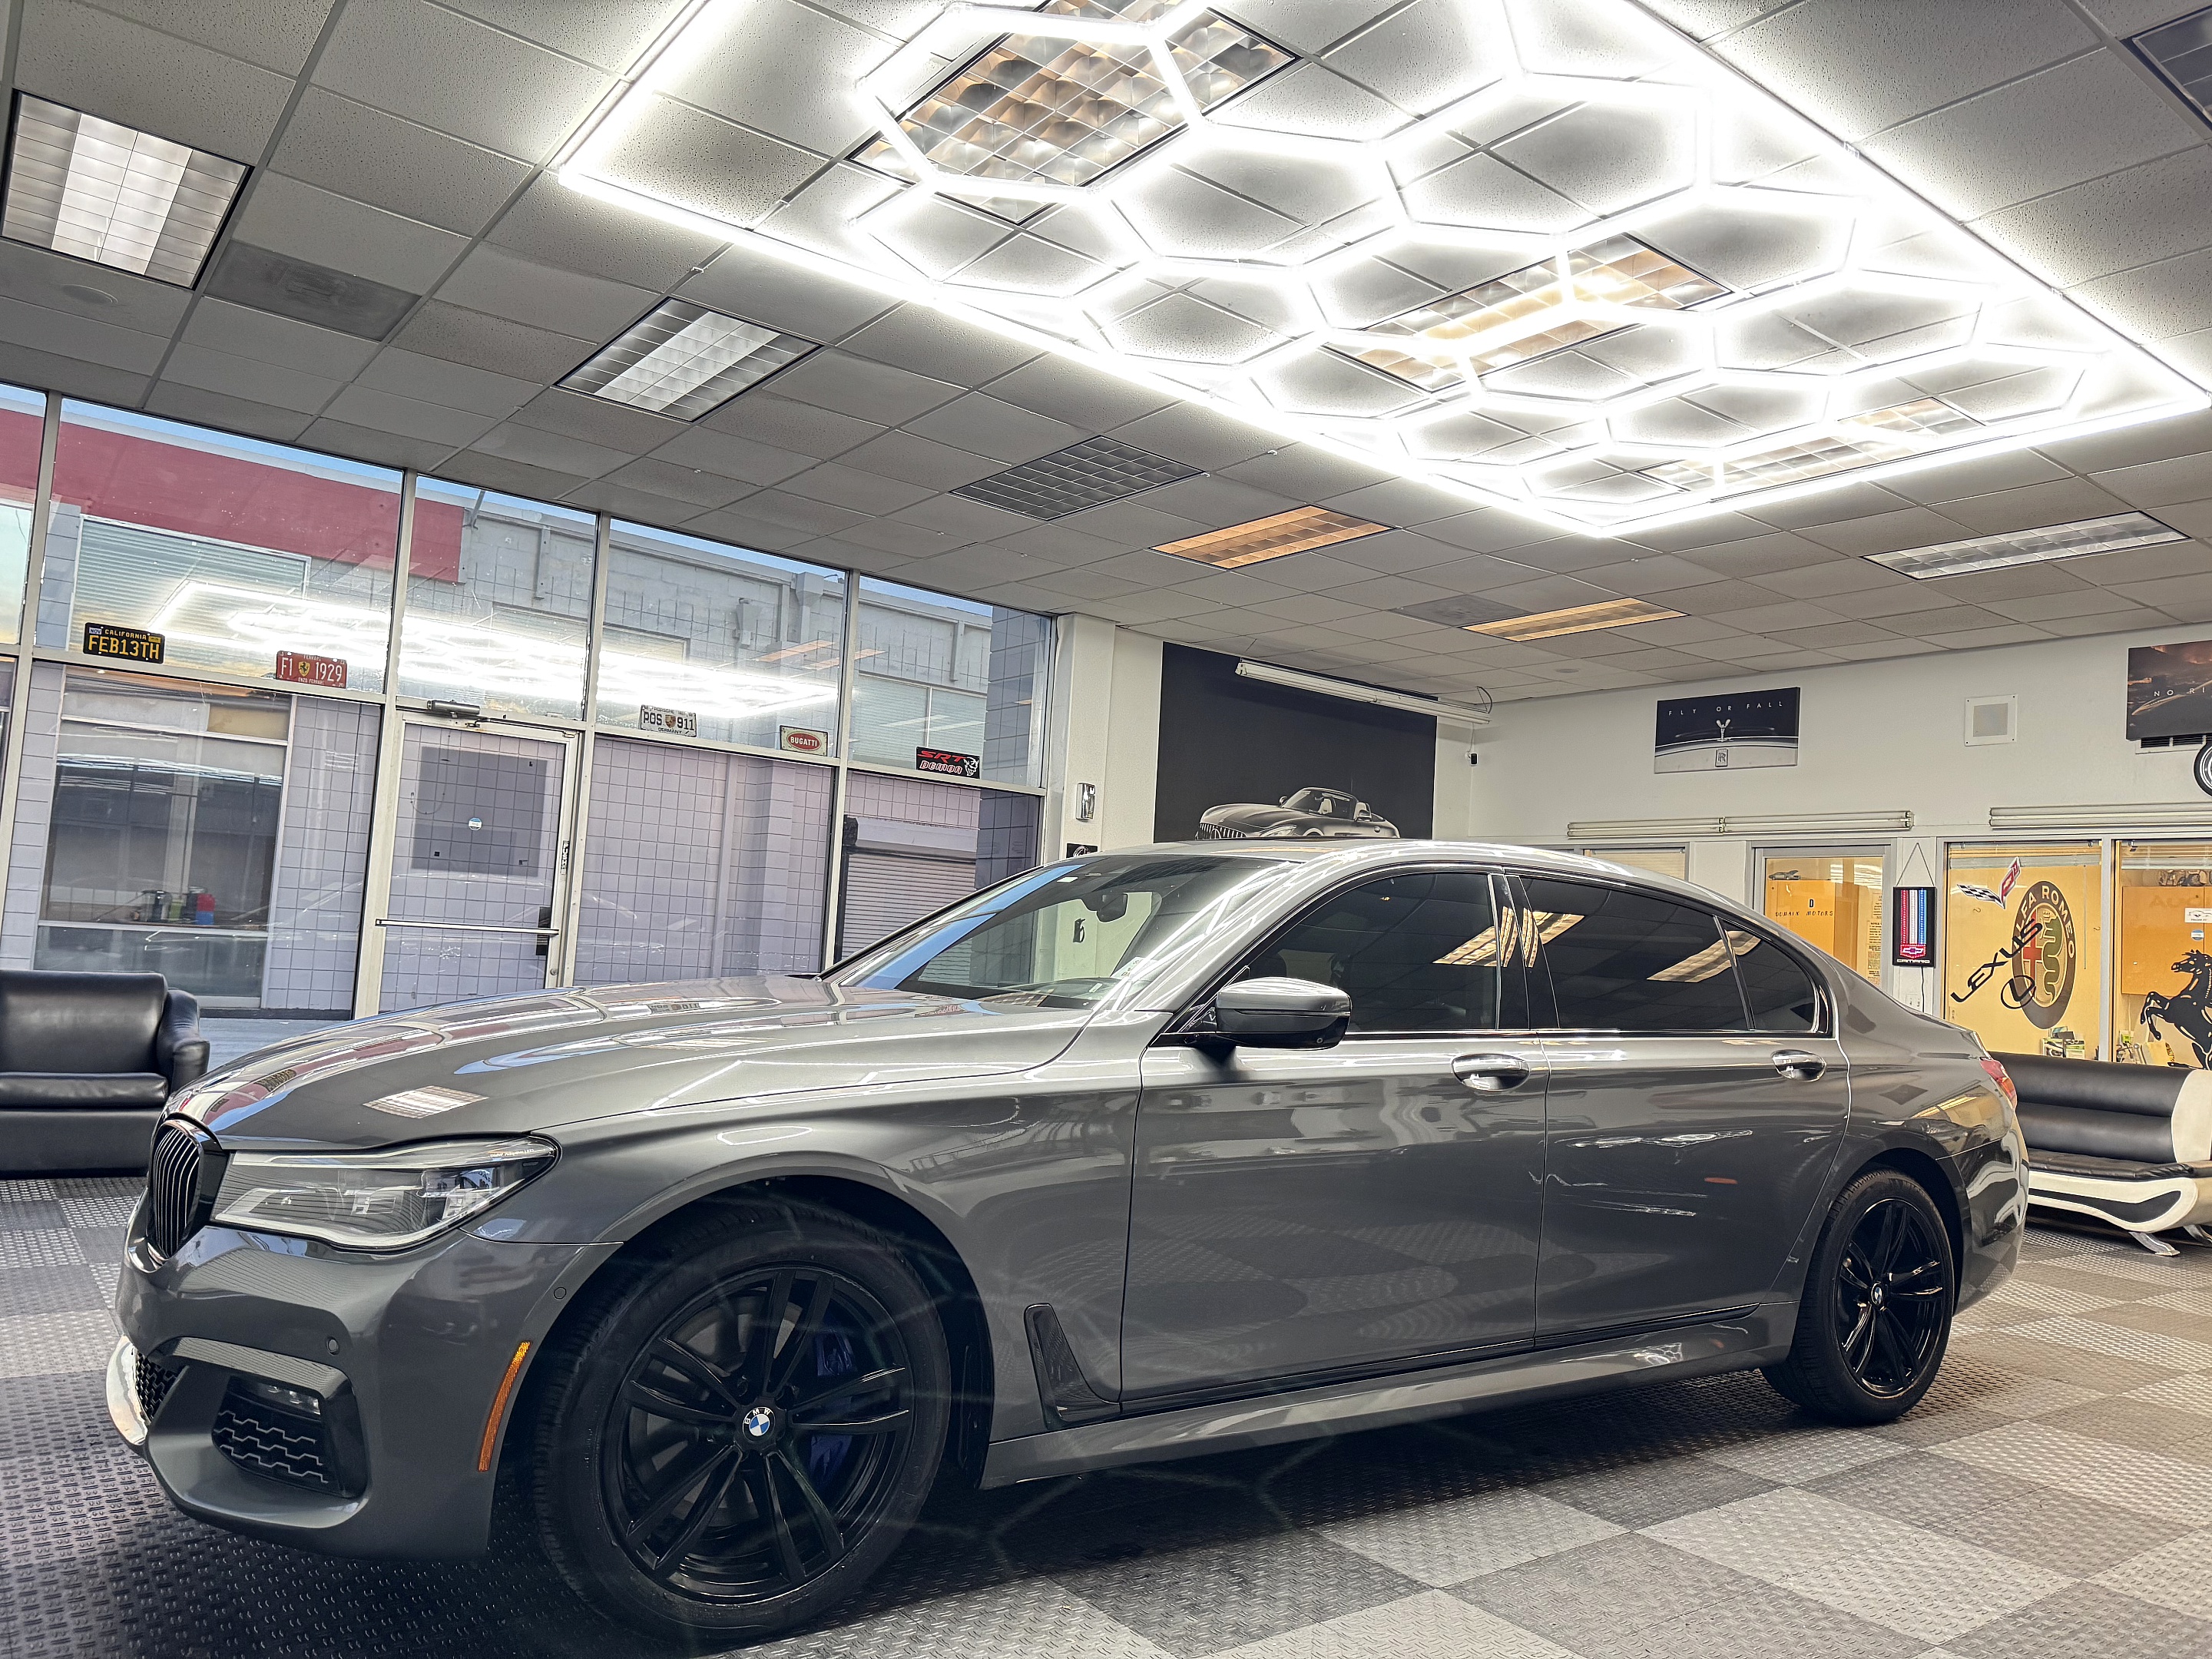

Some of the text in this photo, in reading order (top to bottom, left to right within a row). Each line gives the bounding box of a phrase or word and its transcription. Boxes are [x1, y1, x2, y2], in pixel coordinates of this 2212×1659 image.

[104, 629, 147, 640] CALIFORNIA
[88, 635, 160, 660] FEB13TH
[281, 657, 343, 682] F1 1929
[1746, 700, 1783, 709] FALL
[677, 717, 694, 730] 911
[790, 737, 817, 747] BUGATTI
[917, 750, 967, 763] SRT
[2041, 886, 2075, 958] ROMEO
[1950, 918, 2043, 1003] LEXUS
[744, 1407, 771, 1425] BMW
